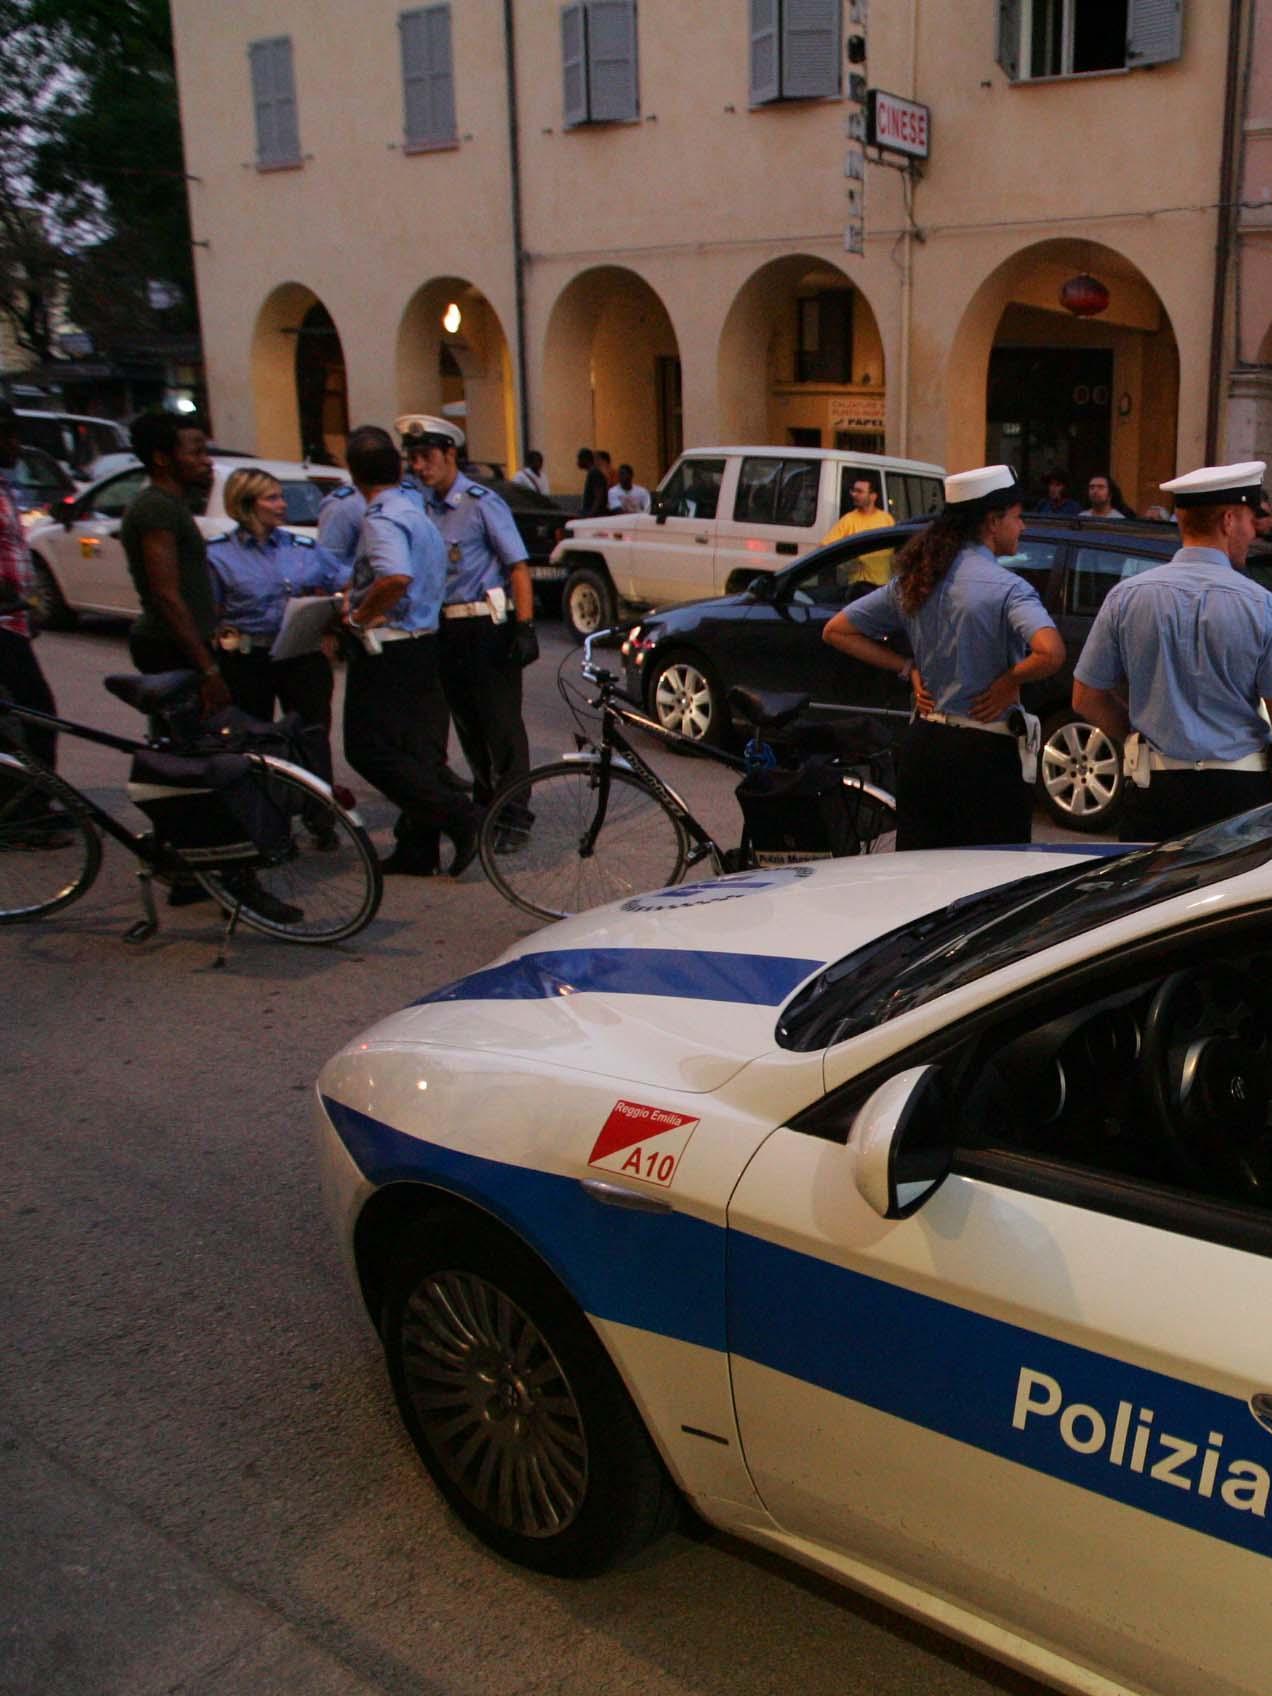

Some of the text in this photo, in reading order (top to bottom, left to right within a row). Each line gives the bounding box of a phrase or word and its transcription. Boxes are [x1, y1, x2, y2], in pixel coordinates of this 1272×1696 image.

[879, 101, 925, 146] CINESE
[614, 1102, 682, 1126] Reggio Emilia
[621, 1147, 675, 1181] A10
[1012, 1367, 1271, 1519] Polizia
